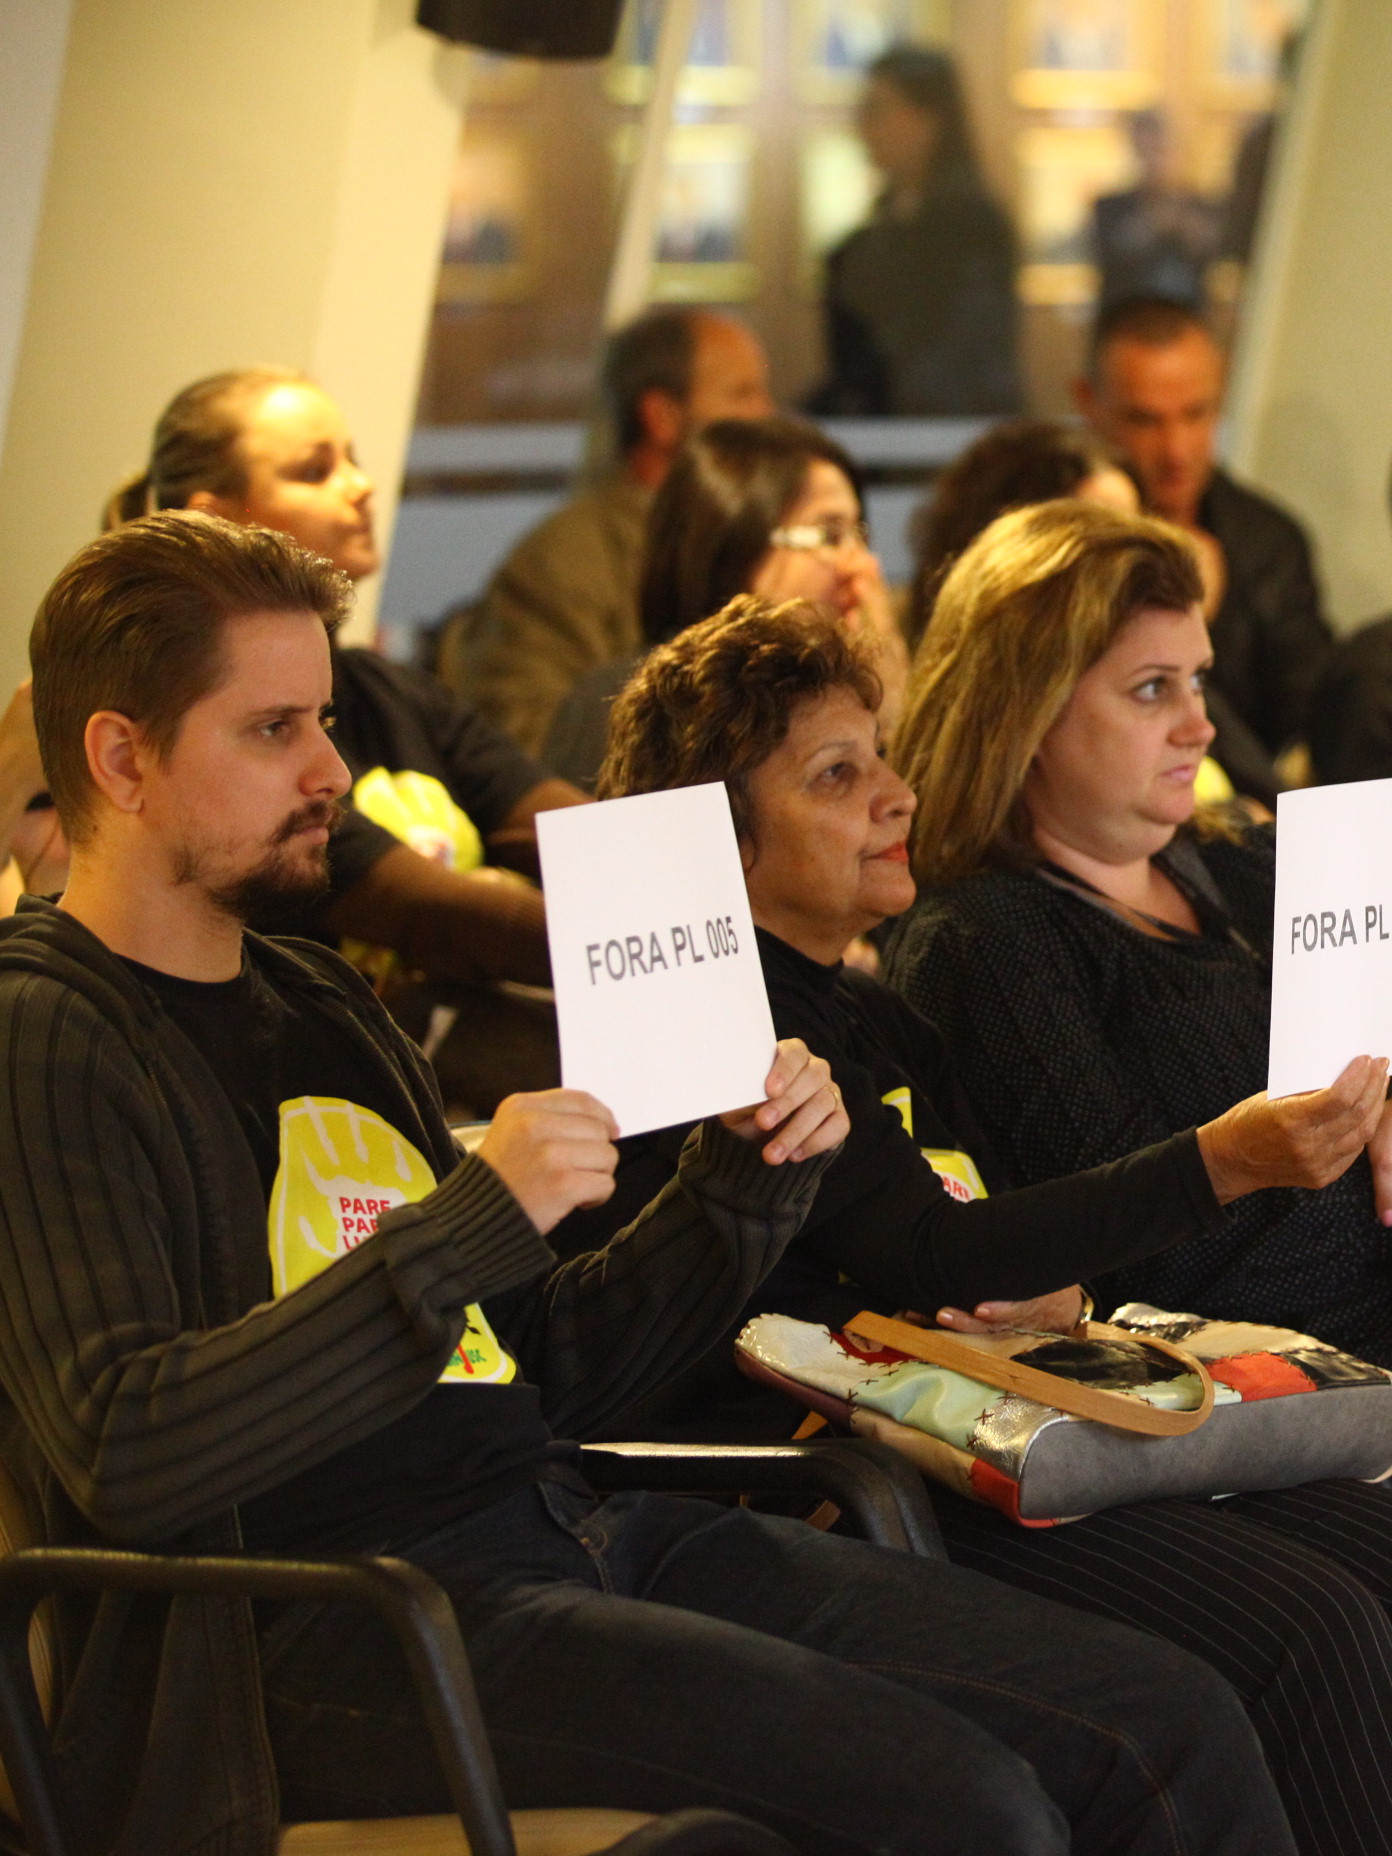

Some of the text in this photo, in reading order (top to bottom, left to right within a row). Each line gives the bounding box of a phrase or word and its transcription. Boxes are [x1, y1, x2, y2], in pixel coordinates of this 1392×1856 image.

[586, 916, 739, 986] FORA PL 005
[1291, 908, 1358, 955] FORA
[1365, 904, 1390, 943] PL
